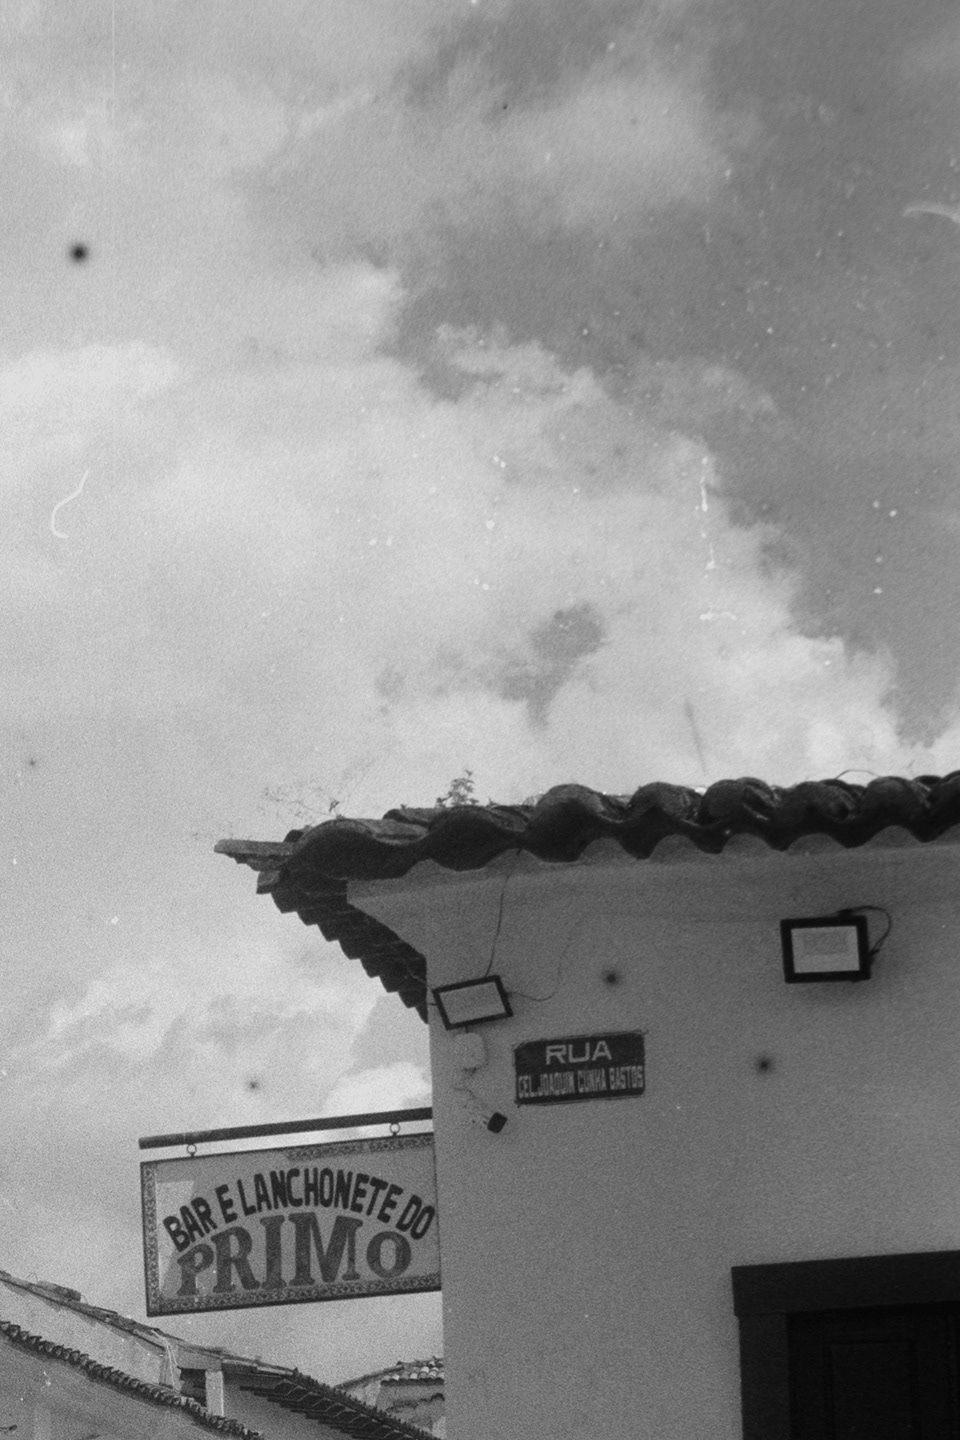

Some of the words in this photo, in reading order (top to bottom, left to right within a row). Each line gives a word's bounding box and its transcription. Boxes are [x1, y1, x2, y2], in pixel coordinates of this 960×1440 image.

[545, 1041, 612, 1066] RUA
[609, 1065, 643, 1090] BASTOS
[163, 1197, 218, 1252] BAR
[215, 1184, 238, 1224] E
[237, 1167, 403, 1223] LANCHONETE
[395, 1194, 436, 1240] DO
[177, 1211, 413, 1298] PRIMO
